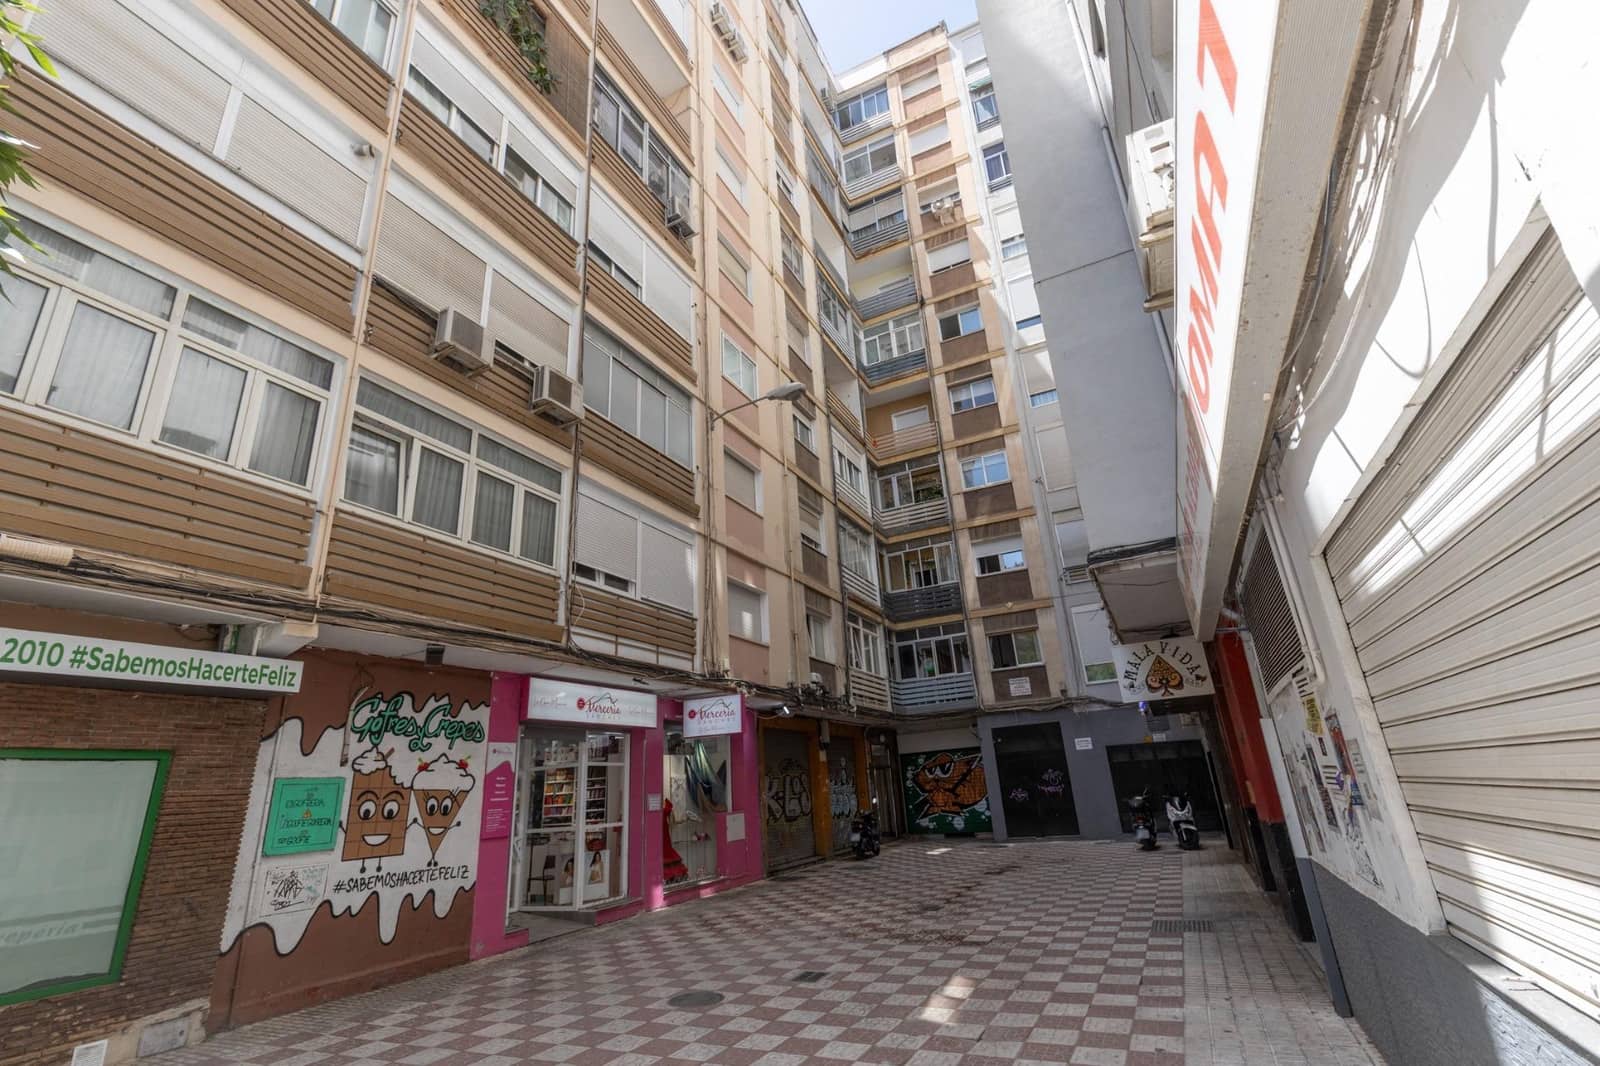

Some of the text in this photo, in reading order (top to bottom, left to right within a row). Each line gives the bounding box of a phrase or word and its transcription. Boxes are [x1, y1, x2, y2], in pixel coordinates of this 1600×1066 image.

[1, 637, 297, 688] 2010 #SabemosHacerteFeliz
[1123, 641, 1201, 682] MALA VIDA
[350, 695, 418, 746] Gofres
[424, 703, 485, 750] Crepes
[333, 864, 470, 894] #SABEMOSHACERTEFELIZ
